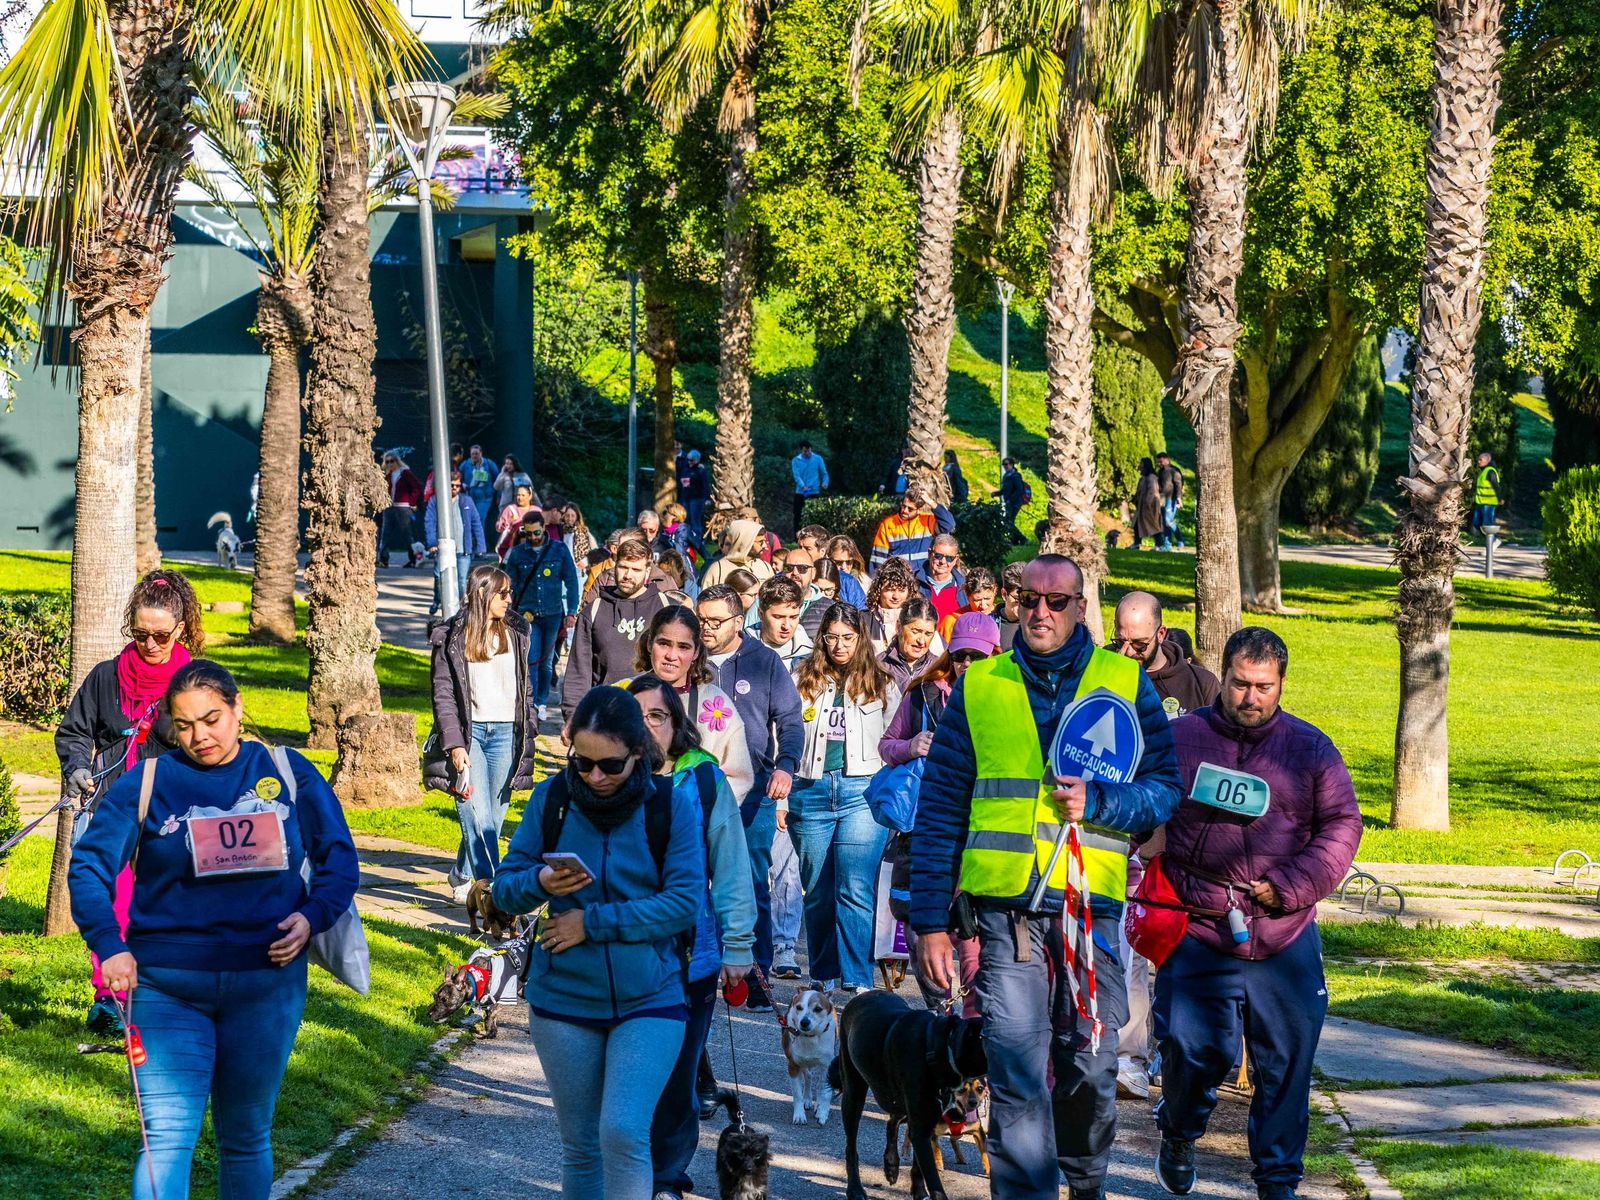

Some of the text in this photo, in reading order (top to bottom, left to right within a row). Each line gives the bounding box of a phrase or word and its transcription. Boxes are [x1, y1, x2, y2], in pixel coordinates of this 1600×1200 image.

[1062, 743, 1123, 783] PRECAUCION
[1215, 778, 1248, 805] 06
[218, 819, 257, 849] 02
[214, 855, 231, 865] San
